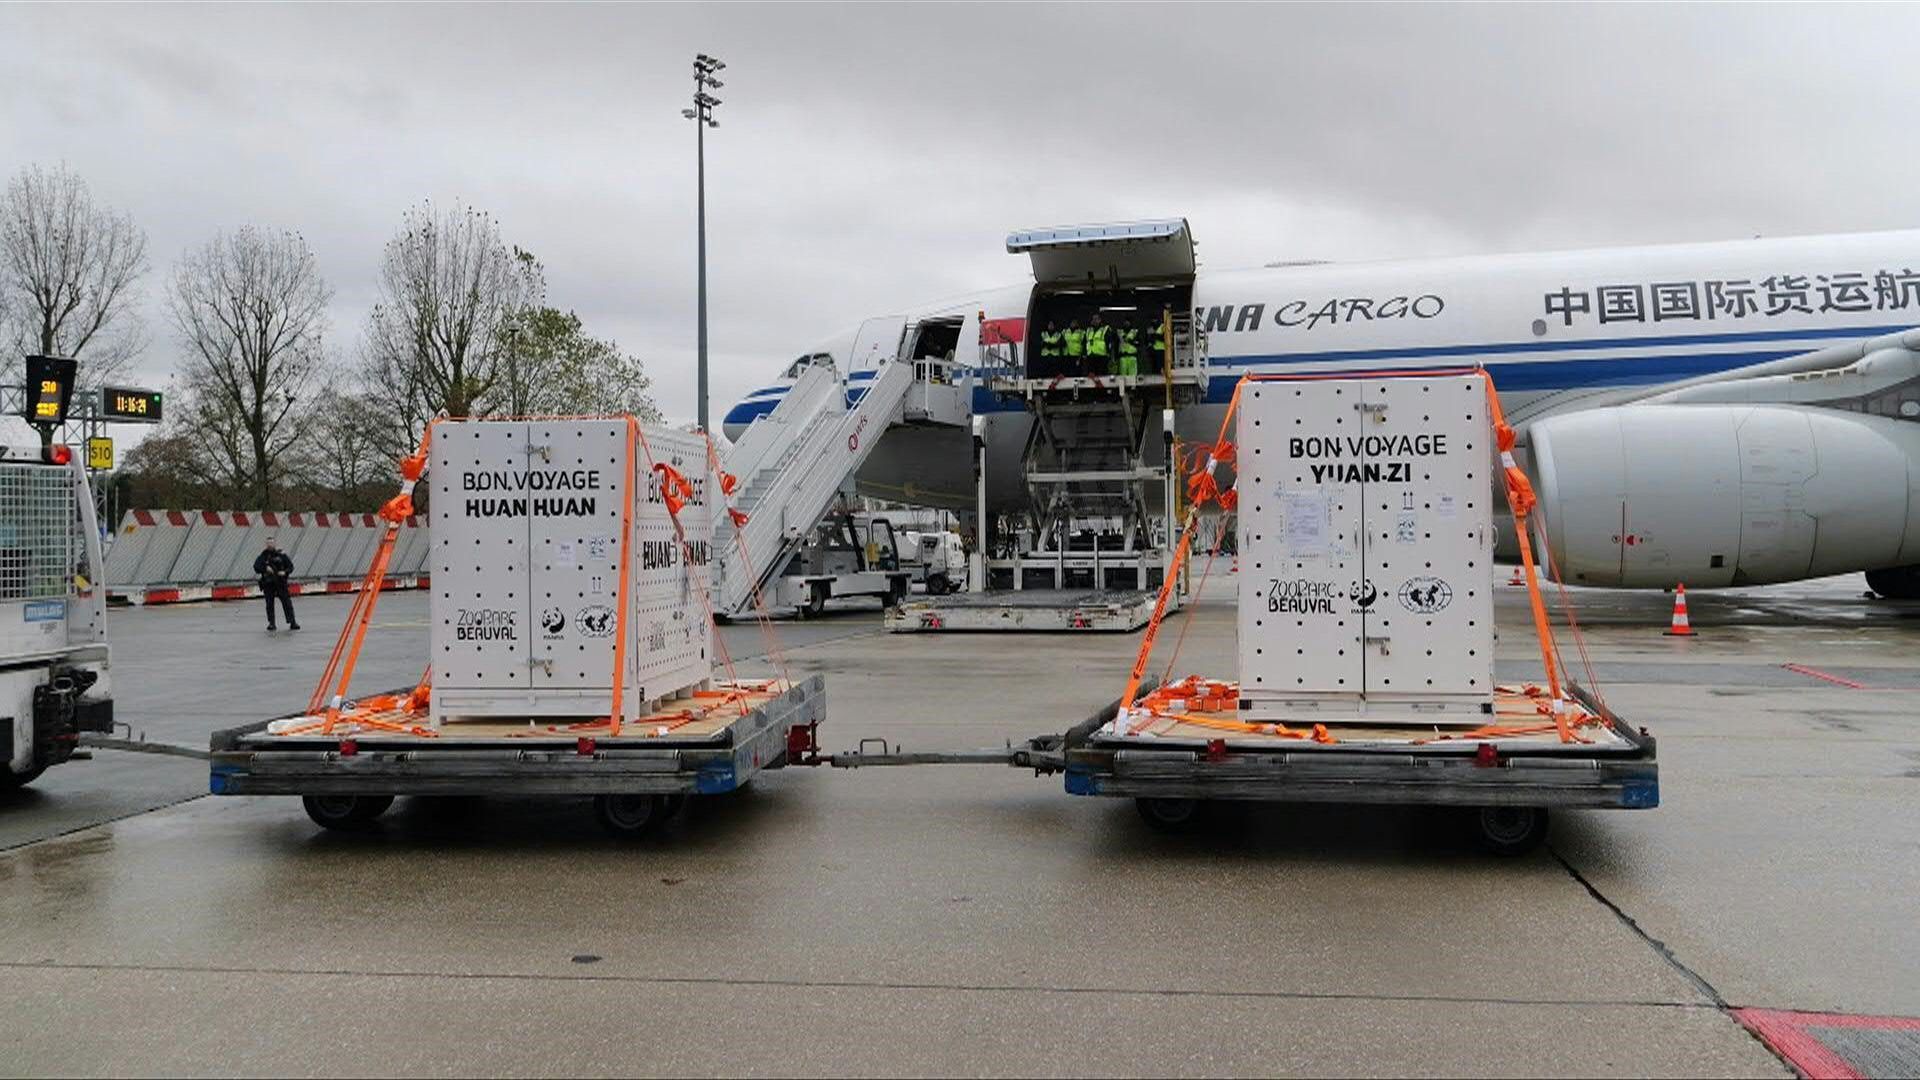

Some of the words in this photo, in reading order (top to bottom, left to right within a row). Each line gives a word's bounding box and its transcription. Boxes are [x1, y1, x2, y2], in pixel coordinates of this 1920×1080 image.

[1545, 268, 1920, 327] 中国国际货运航
[1274, 294, 1445, 331] CARGO
[91, 446, 111, 460] S10
[1290, 437, 1342, 458] BON
[1347, 434, 1447, 457] VOYAGE
[463, 471, 507, 491] BON
[513, 470, 600, 491] VOYAGE
[1310, 463, 1380, 484] YUAN
[1387, 463, 1411, 482] ZI
[465, 499, 527, 517] HUAN
[533, 498, 596, 517] HUAN
[643, 541, 671, 570] HUAN
[1268, 598, 1337, 614] BEAUVAL
[457, 626, 518, 640] BEAUVAL
